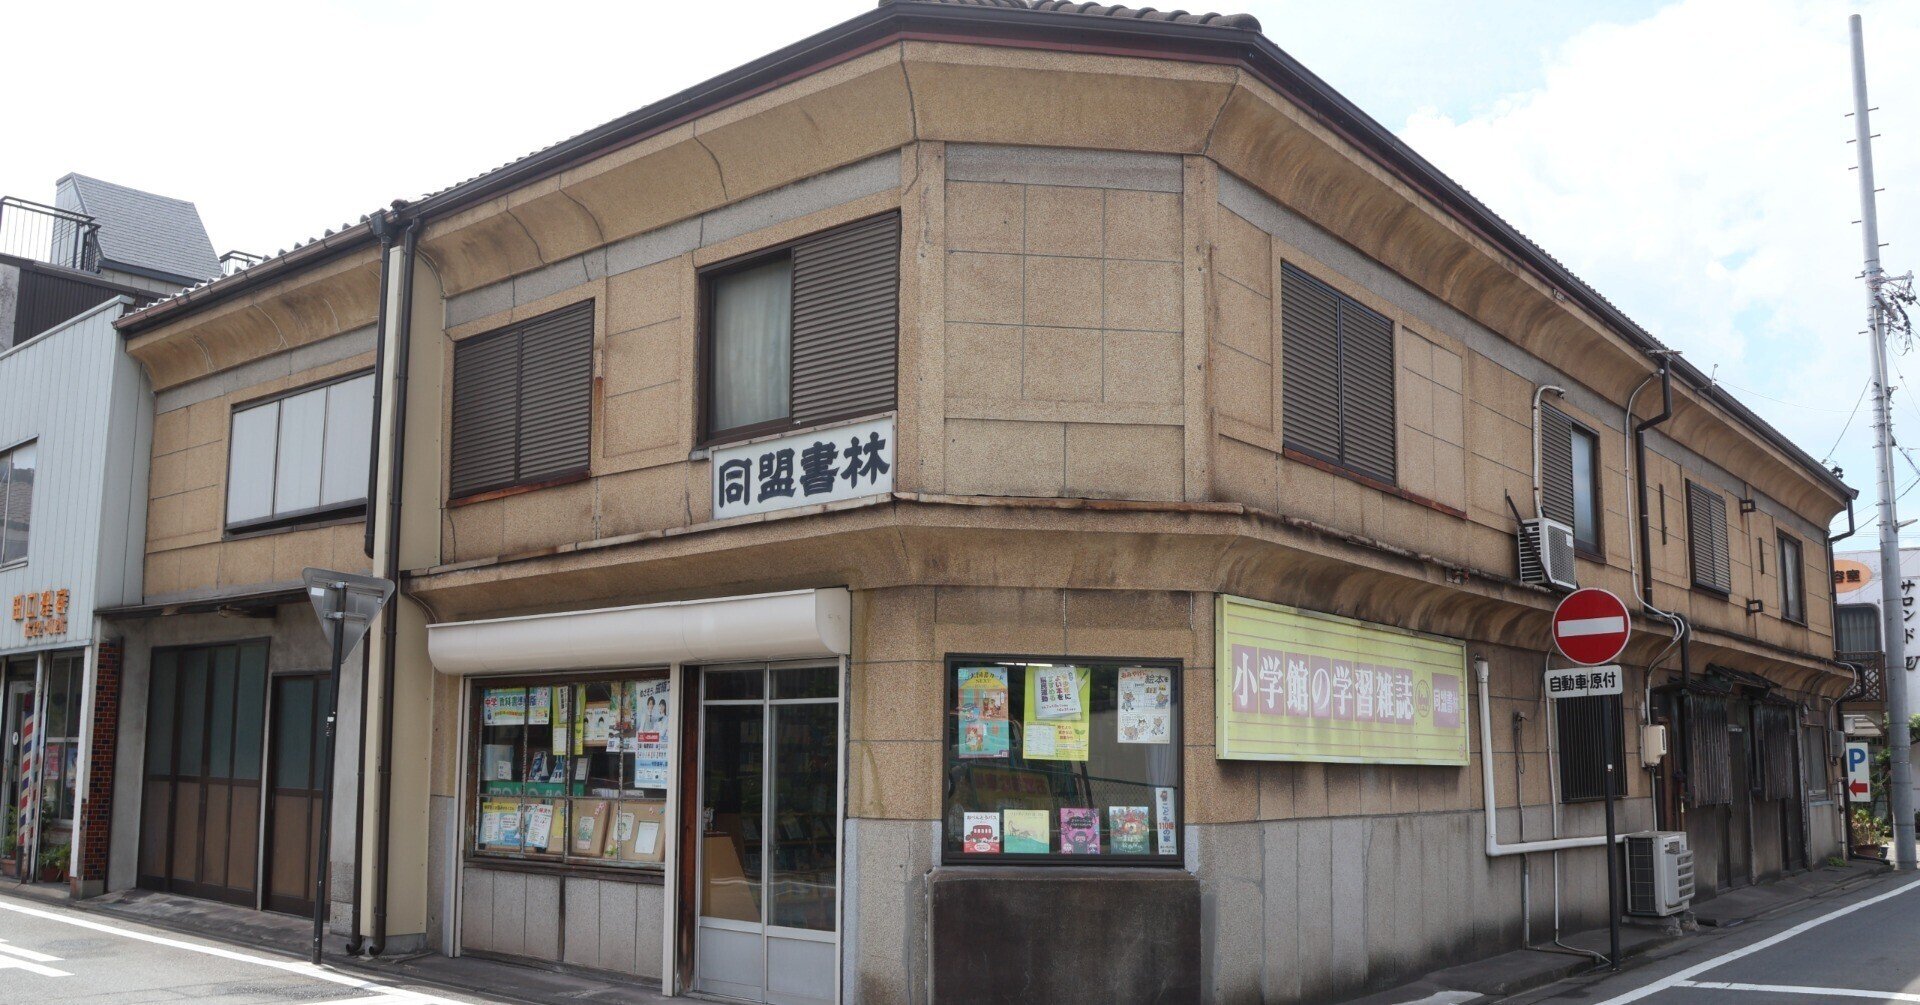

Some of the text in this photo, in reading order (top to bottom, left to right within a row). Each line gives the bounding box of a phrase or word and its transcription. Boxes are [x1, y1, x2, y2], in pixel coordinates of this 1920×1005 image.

[718, 431, 891, 508] 同盟書林
[1233, 652, 1415, 720] 小学館の学習雑誌
[1849, 748, 1866, 772] P
